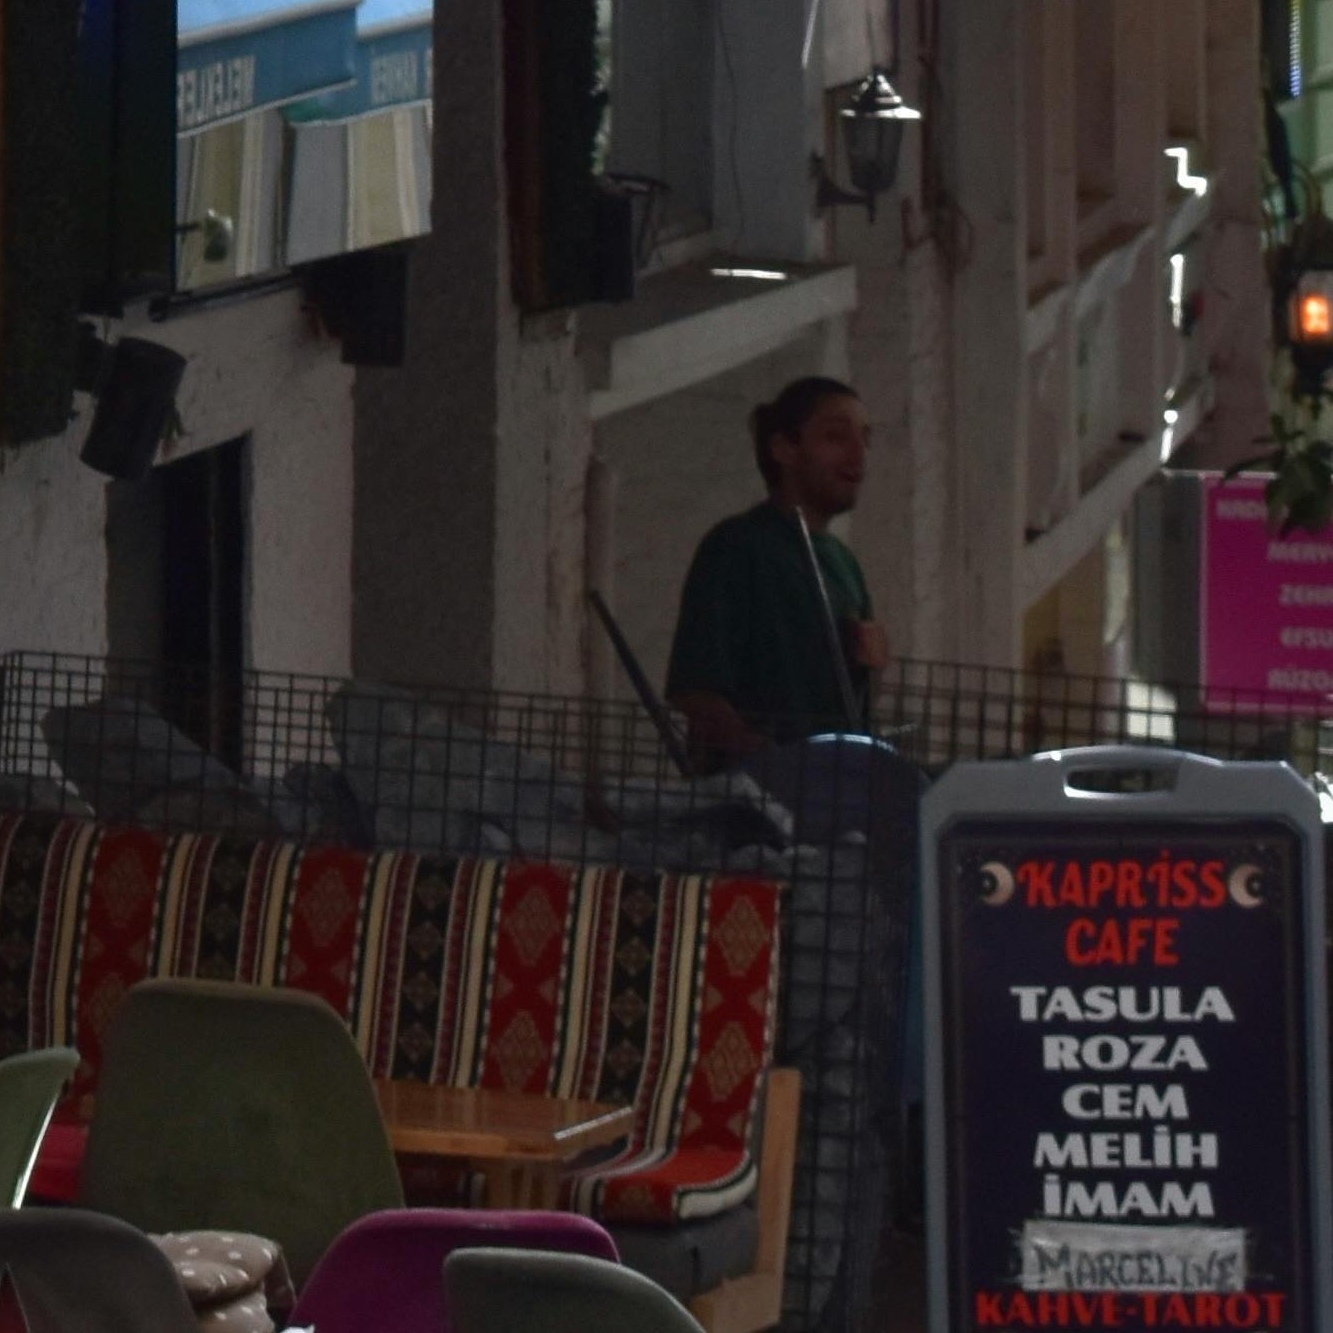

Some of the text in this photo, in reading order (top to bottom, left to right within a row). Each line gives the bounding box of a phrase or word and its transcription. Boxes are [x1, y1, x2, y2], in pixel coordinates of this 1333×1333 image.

[1016, 851, 1231, 908] KAPRİSS
[1065, 919, 1179, 965] CAFE
[1010, 986, 1235, 1022] TASULA
[1043, 1035, 1208, 1071] ROZA
[1061, 1083, 1189, 1120] CEM
[1034, 1125, 1218, 1168] MELİH
[1042, 1173, 1214, 1217] İMAM
[974, 1291, 1286, 1328] KAHVE-TAROT
